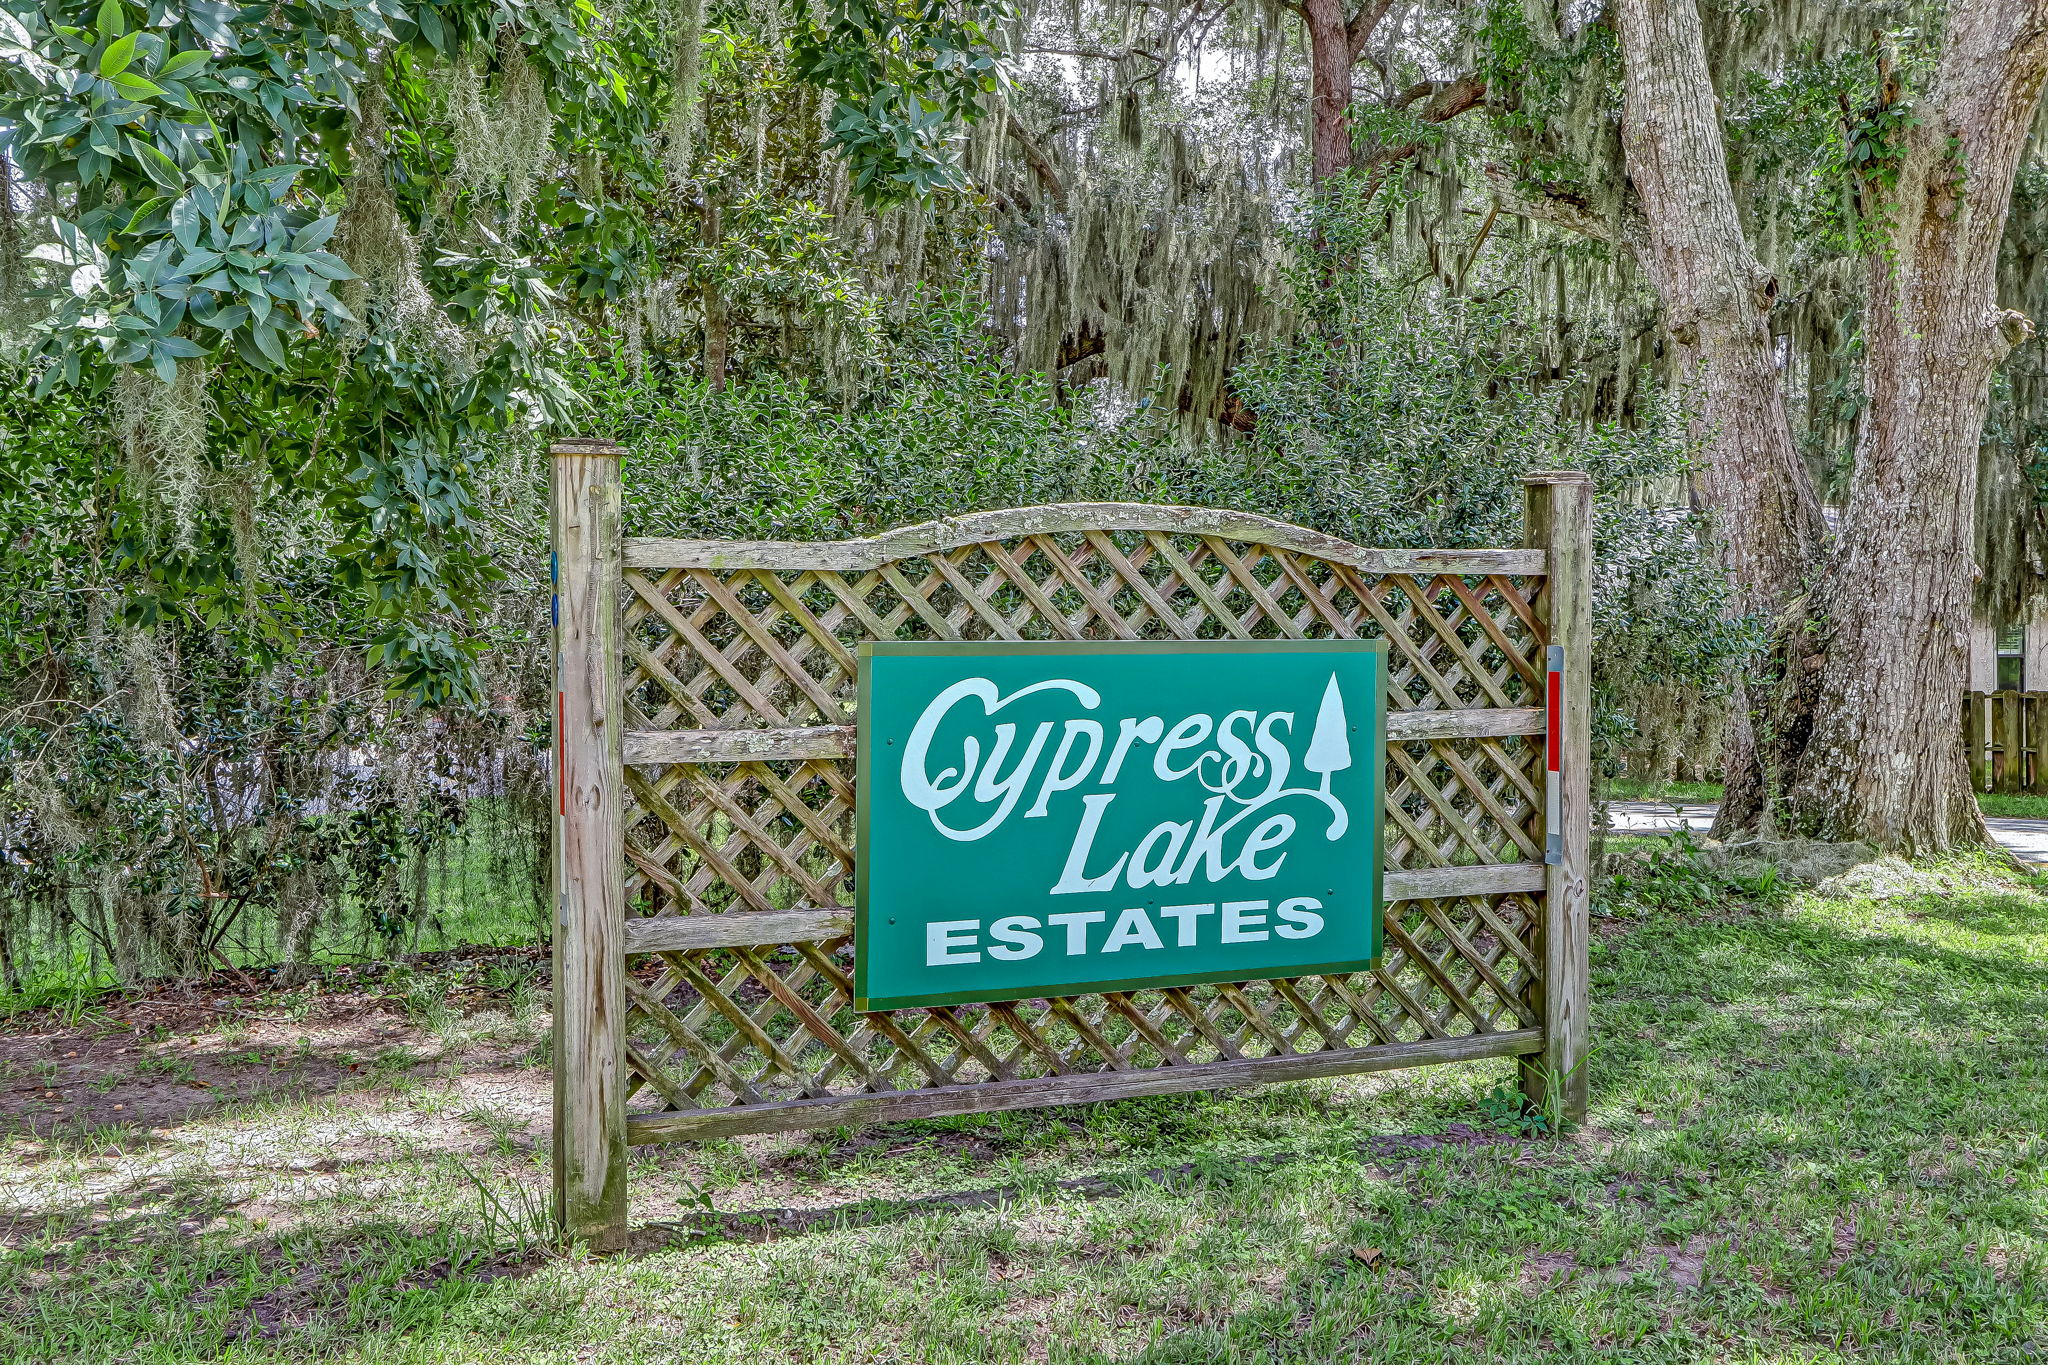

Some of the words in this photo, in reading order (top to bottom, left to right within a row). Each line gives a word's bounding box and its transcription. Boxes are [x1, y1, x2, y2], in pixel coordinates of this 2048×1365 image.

[901, 677, 1295, 841] Cypress
[1050, 793, 1297, 895] Lake
[926, 896, 1325, 967] ESTATES
